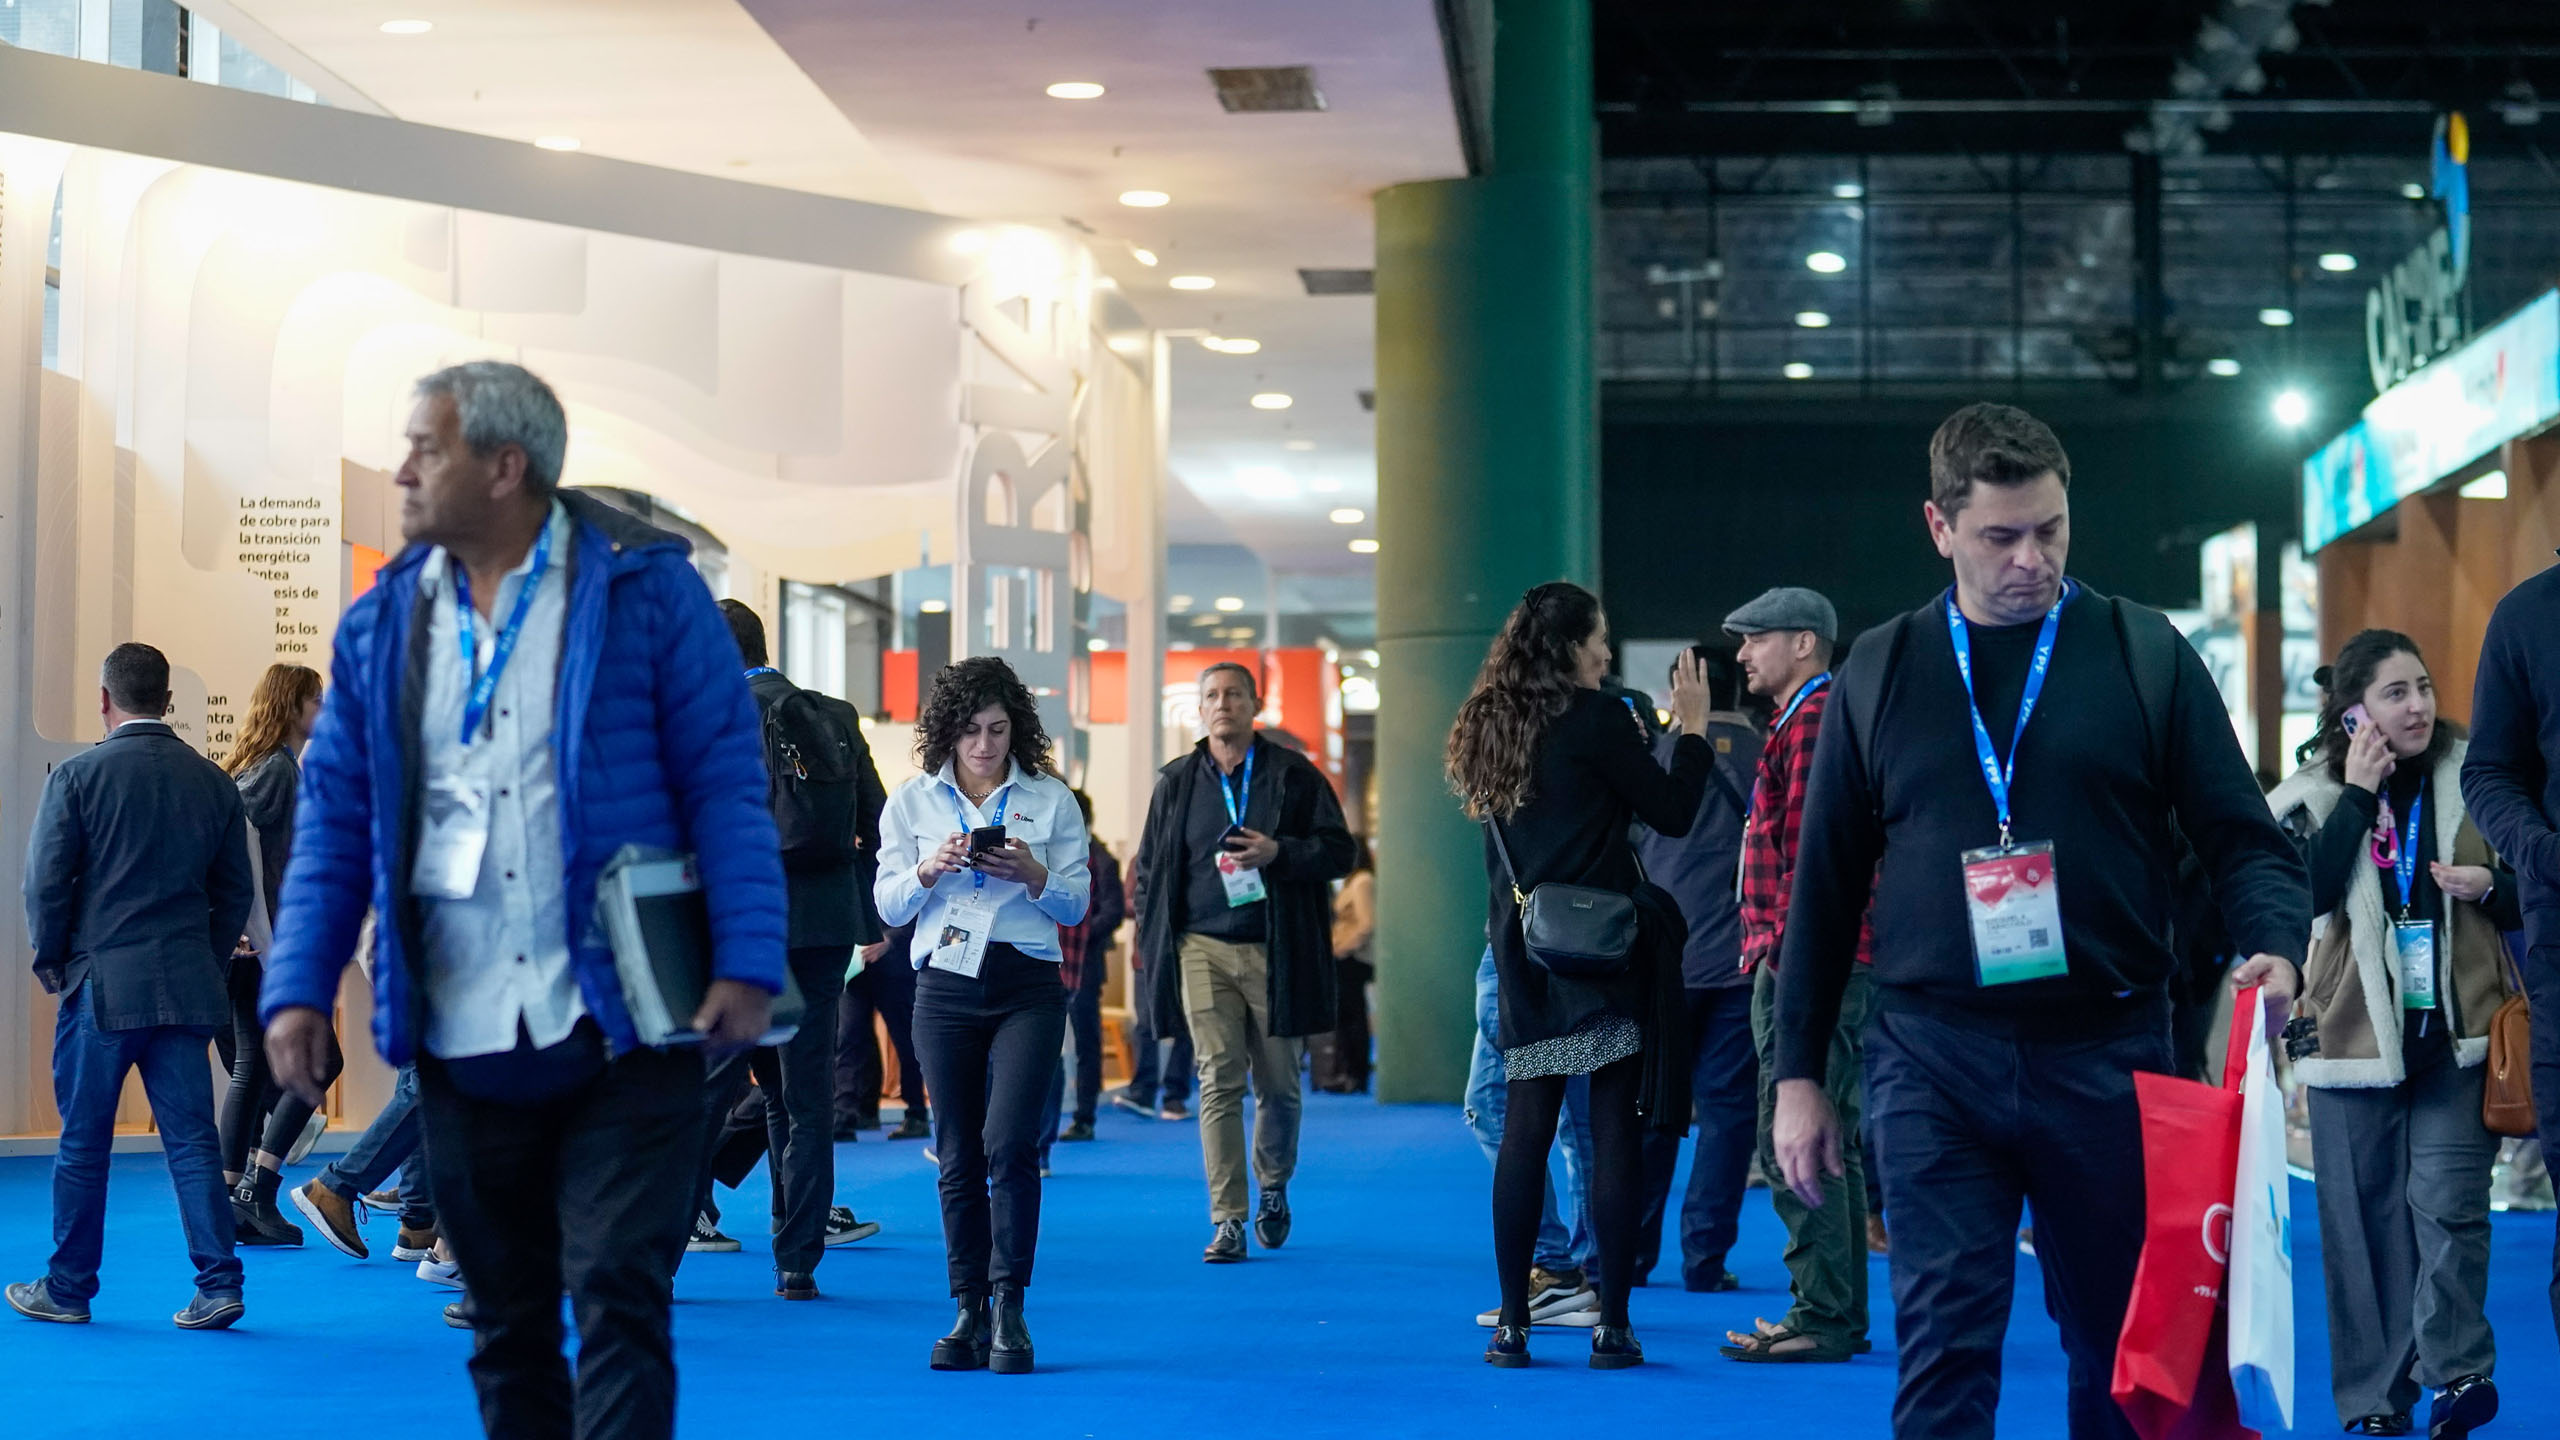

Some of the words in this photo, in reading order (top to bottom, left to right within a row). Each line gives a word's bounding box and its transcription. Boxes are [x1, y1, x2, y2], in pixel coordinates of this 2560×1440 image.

[240, 497, 255, 509] La
[259, 496, 321, 509] demanda
[239, 514, 256, 527] de
[259, 514, 297, 527] cobre
[301, 518, 330, 528] para
[239, 532, 251, 545] la
[255, 532, 320, 545] transición
[239, 550, 310, 565] energética
[274, 587, 299, 599] esis
[302, 586, 319, 599] de
[275, 606, 289, 617] ez
[299, 622, 318, 635] los
[275, 640, 308, 653] arios
[2035, 645, 2050, 676] YPF
[207, 712, 234, 724] ntra
[215, 730, 232, 743] de
[1984, 755, 2001, 785] YPF
[2408, 822, 2417, 840] YPF
